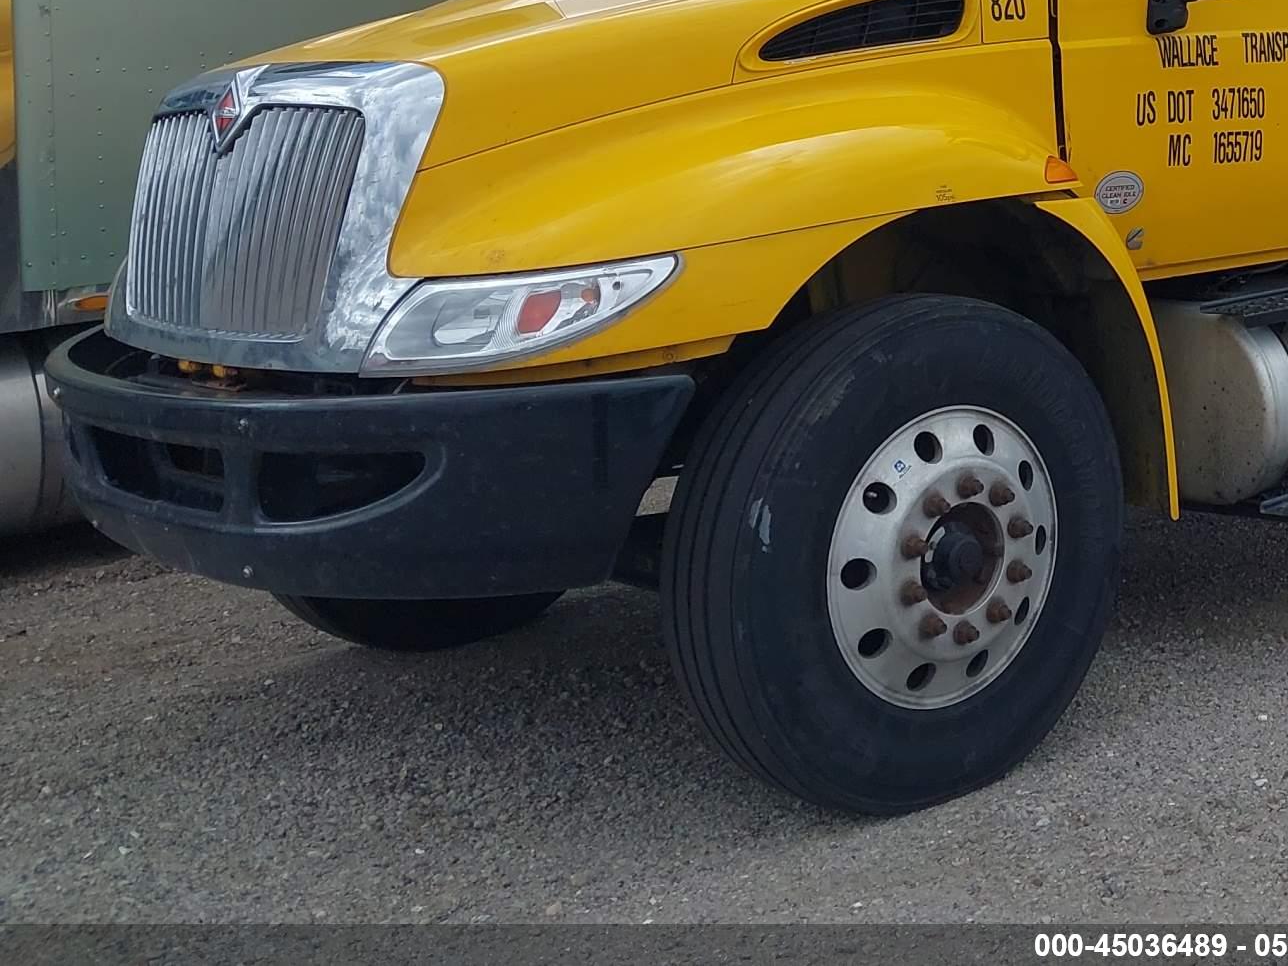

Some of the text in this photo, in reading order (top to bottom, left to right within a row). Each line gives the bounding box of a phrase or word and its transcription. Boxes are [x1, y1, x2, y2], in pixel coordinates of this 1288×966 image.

[1157, 34, 1219, 68] WALLACE
[1136, 87, 1266, 126] US DOT 3471650
[1167, 129, 1263, 167] MC 1655719
